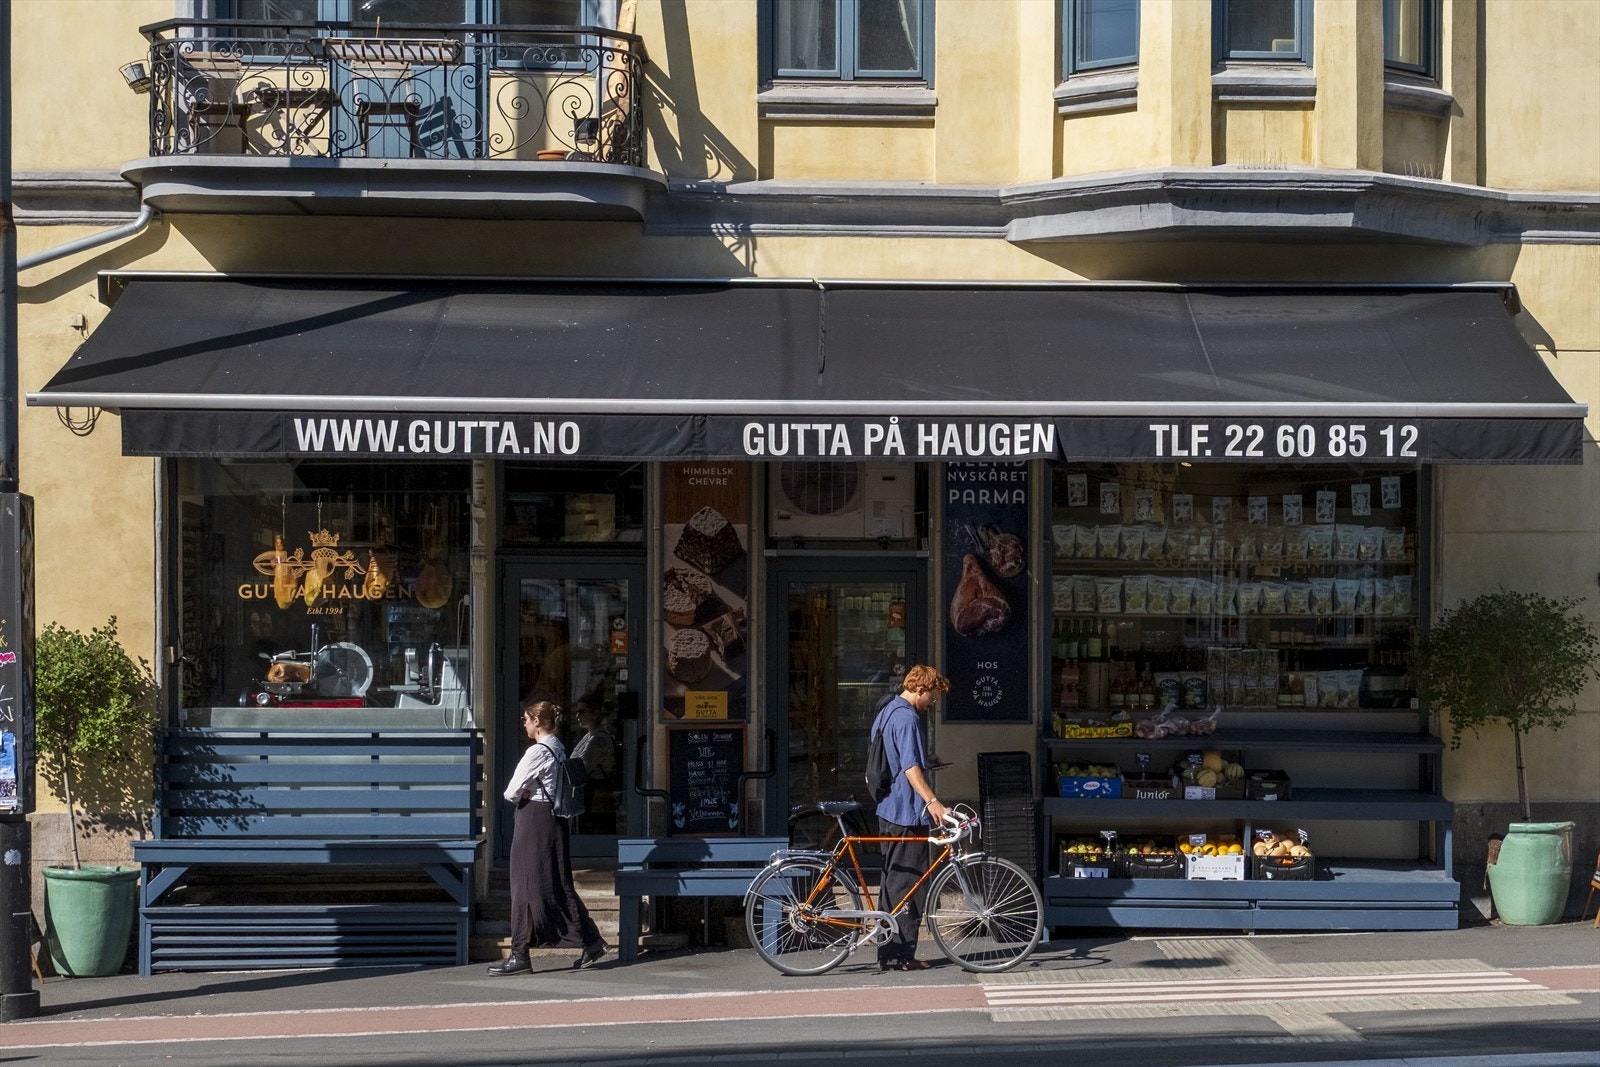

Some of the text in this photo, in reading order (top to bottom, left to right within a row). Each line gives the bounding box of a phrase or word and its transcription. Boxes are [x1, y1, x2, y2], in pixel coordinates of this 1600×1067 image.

[293, 418, 581, 456] WWW.GUTTA.NO
[742, 415, 1055, 456] GUTTA PÅ HAUGEN
[1149, 424, 1419, 458] TLF. 22 60 85 12
[683, 467, 734, 475] HIMMELSK
[947, 468, 1028, 482] NYSKÅRET
[688, 477, 728, 486] CHEVRE
[949, 489, 1025, 504] PARMA
[322, 584, 412, 599] HAUGEN
[325, 607, 344, 615] 1994
[977, 661, 998, 669] HOS
[975, 676, 999, 686] GUTTA
